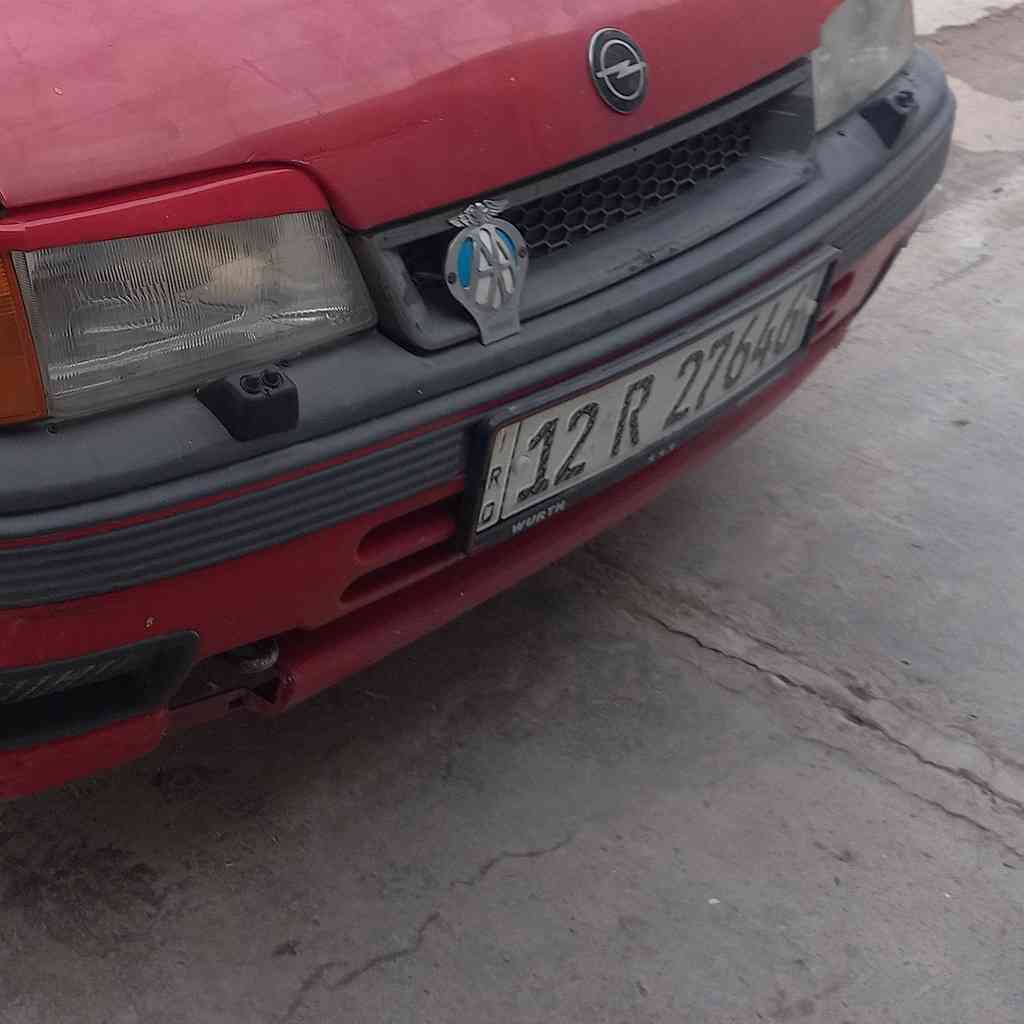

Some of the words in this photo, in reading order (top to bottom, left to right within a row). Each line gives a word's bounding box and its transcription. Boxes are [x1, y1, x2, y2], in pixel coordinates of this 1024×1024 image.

[517, 402, 600, 503] 12
[610, 374, 655, 458] R
[662, 284, 808, 431] 27646
